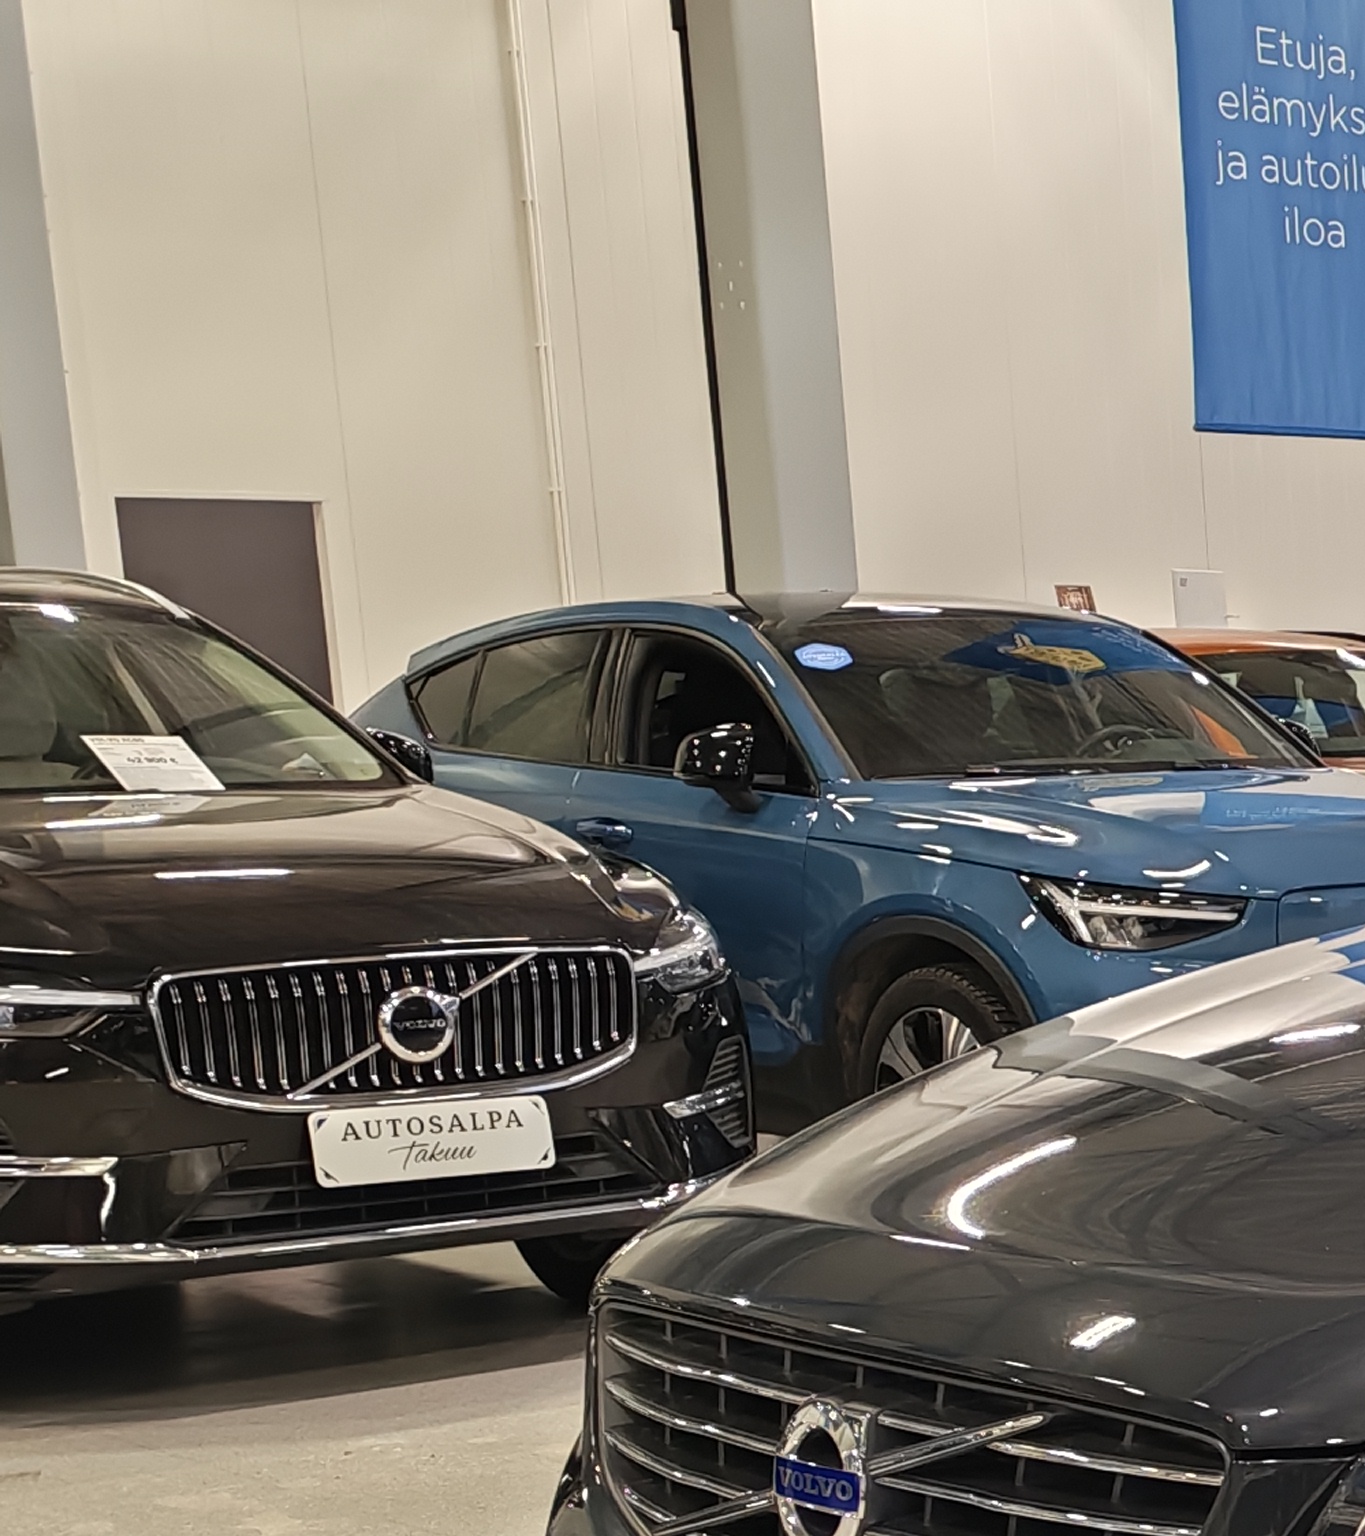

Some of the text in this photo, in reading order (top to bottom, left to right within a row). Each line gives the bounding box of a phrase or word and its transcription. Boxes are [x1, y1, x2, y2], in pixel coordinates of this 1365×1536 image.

[1255, 25, 1356, 81] Etuja,
[1215, 139, 1248, 186] ja
[1283, 205, 1347, 249] iloa
[392, 1018, 447, 1031] VOLVO
[341, 1108, 525, 1143] AUTOSALPA
[387, 1140, 477, 1171] Takuu
[777, 1464, 853, 1503] VOLVO
